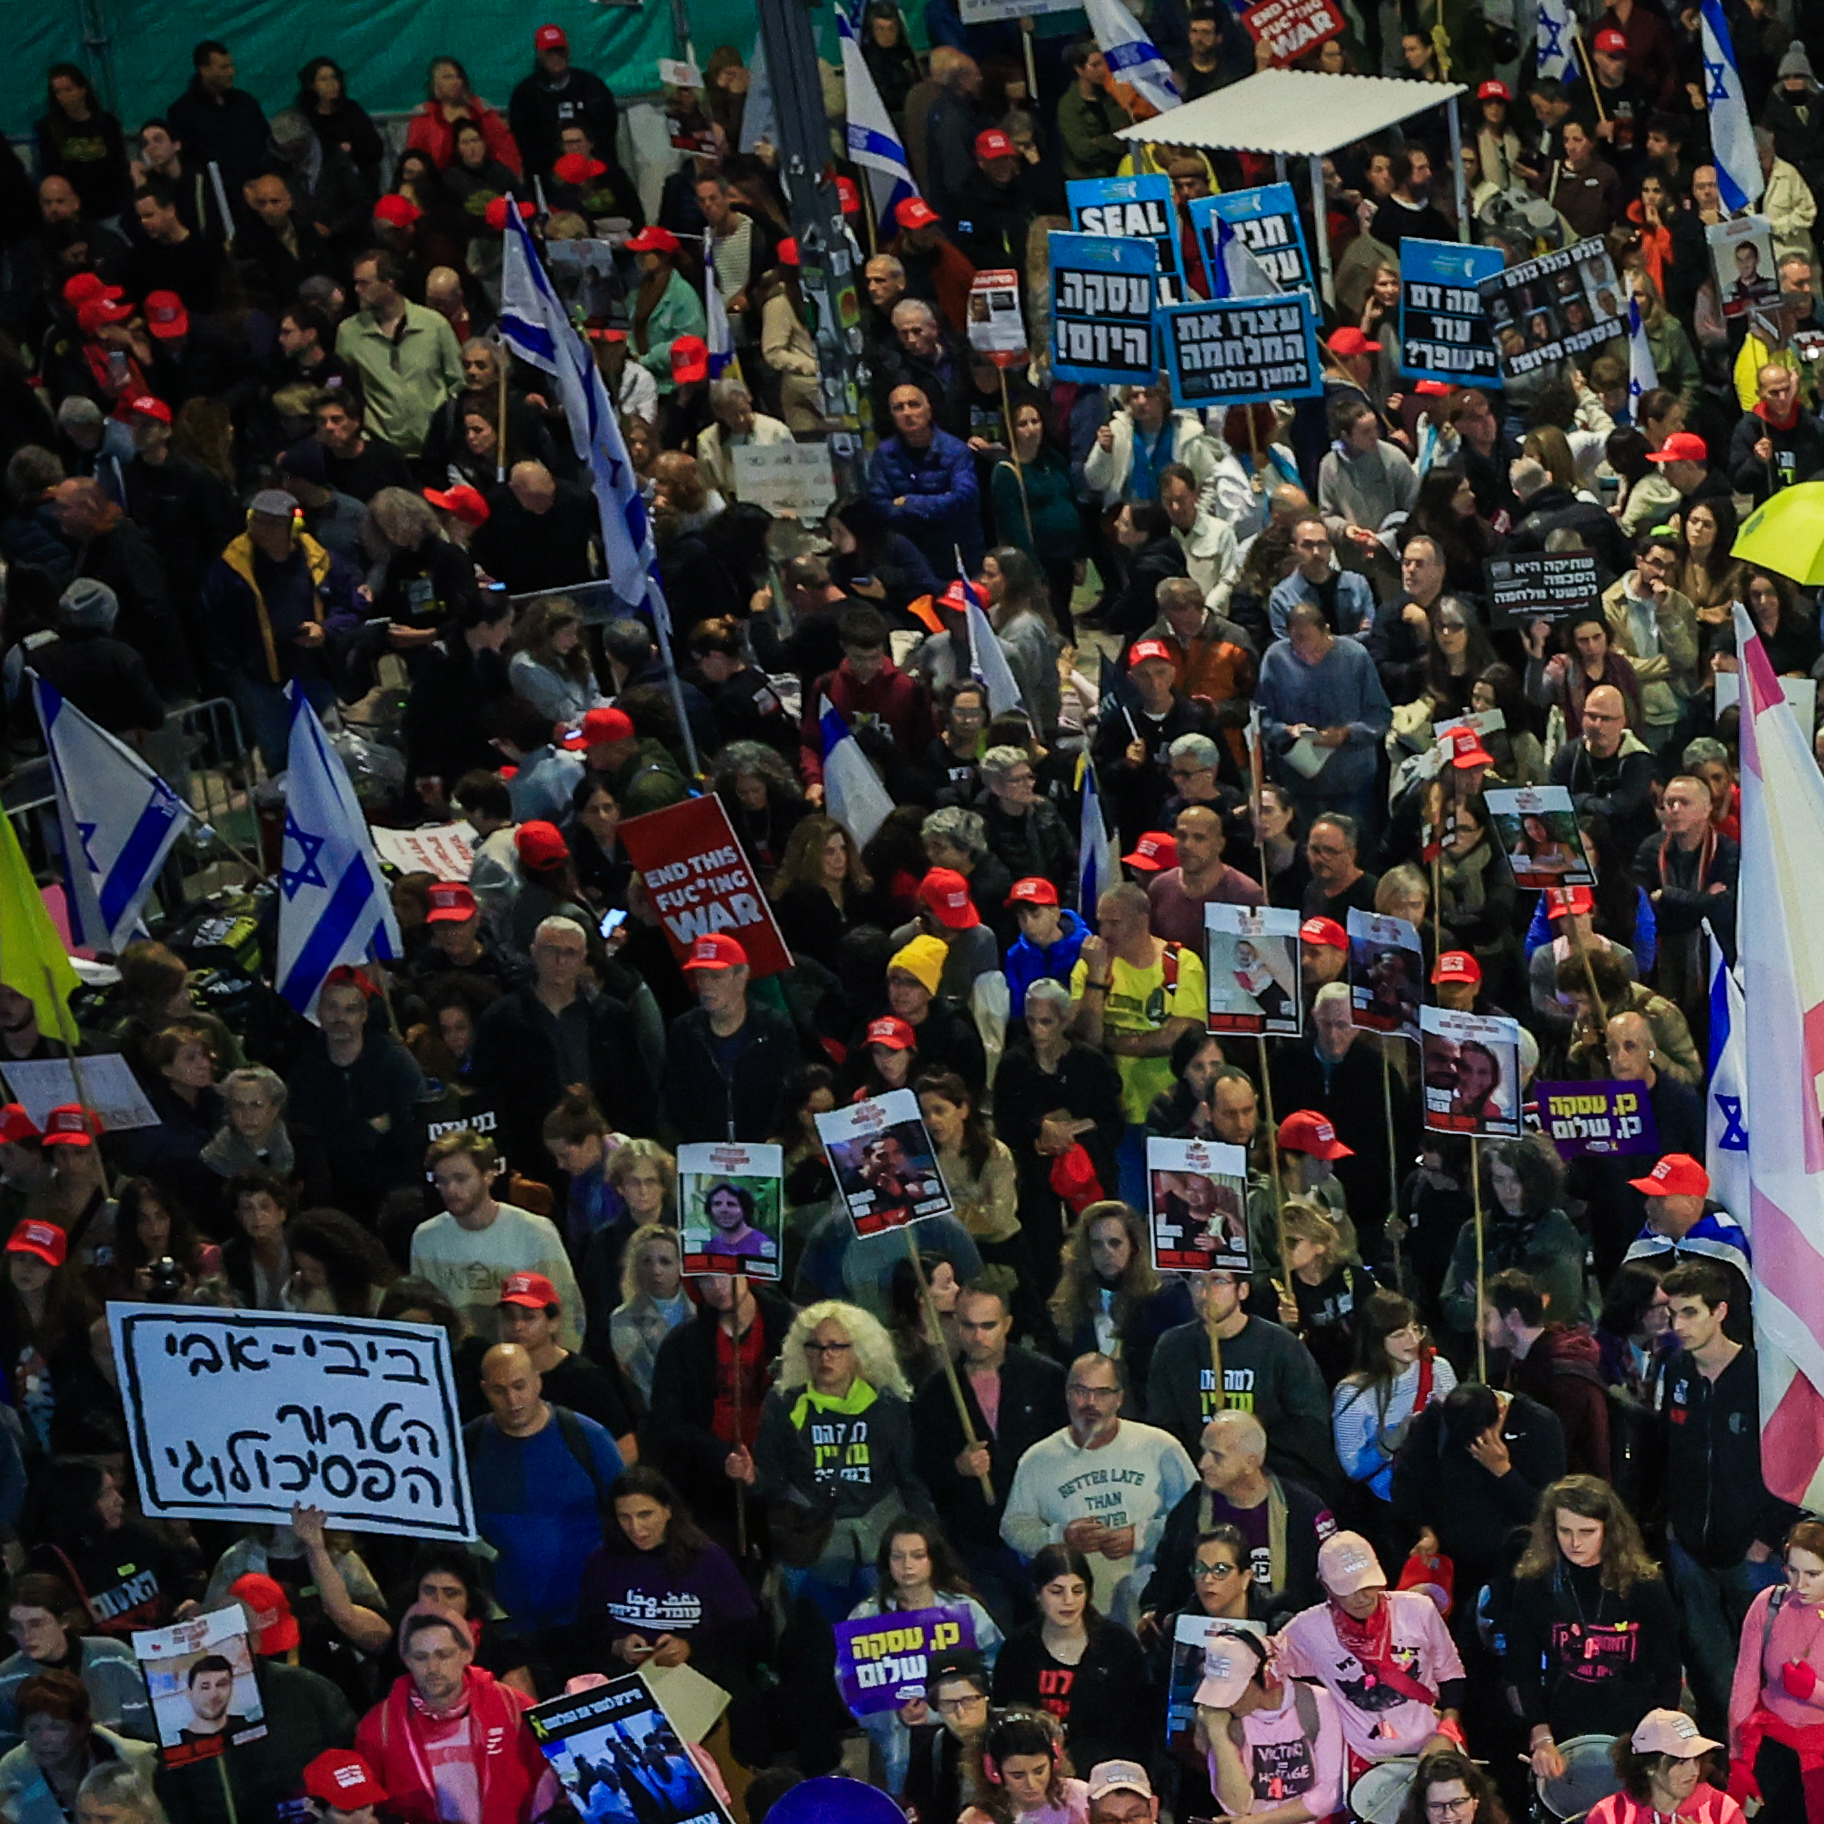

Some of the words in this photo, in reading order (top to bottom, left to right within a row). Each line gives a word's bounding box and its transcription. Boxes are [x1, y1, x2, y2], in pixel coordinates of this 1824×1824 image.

[1269, 10, 1336, 58] WAR
[1177, 313, 1222, 340] את
[1230, 307, 1301, 334] עצרו
[1431, 317, 1472, 343] עוד
[1058, 321, 1148, 366] היום!
[1179, 334, 1305, 370] המלחמה
[1210, 370, 1258, 390] כולנו
[1263, 363, 1308, 387] למען
[644, 861, 687, 887] END
[687, 846, 738, 879] THIS
[663, 893, 764, 945] WAR
[1548, 1095, 1608, 1119] עסקה
[1611, 1093, 1639, 1117] כן,
[1551, 1117, 1611, 1140] שלום
[1615, 1116, 1642, 1140] כן,
[164, 1333, 430, 1388] ביבי-אבי
[276, 1403, 440, 1460] הטרור
[164, 1431, 443, 1508] הפסיכולוגי
[1058, 1469, 1109, 1500] BETTER
[1110, 1468, 1146, 1488] LATE
[1084, 1491, 1123, 1511] THAN
[850, 1626, 925, 1661] עסקה
[929, 1622, 960, 1652] כן,
[855, 1654, 929, 1689] שלום
